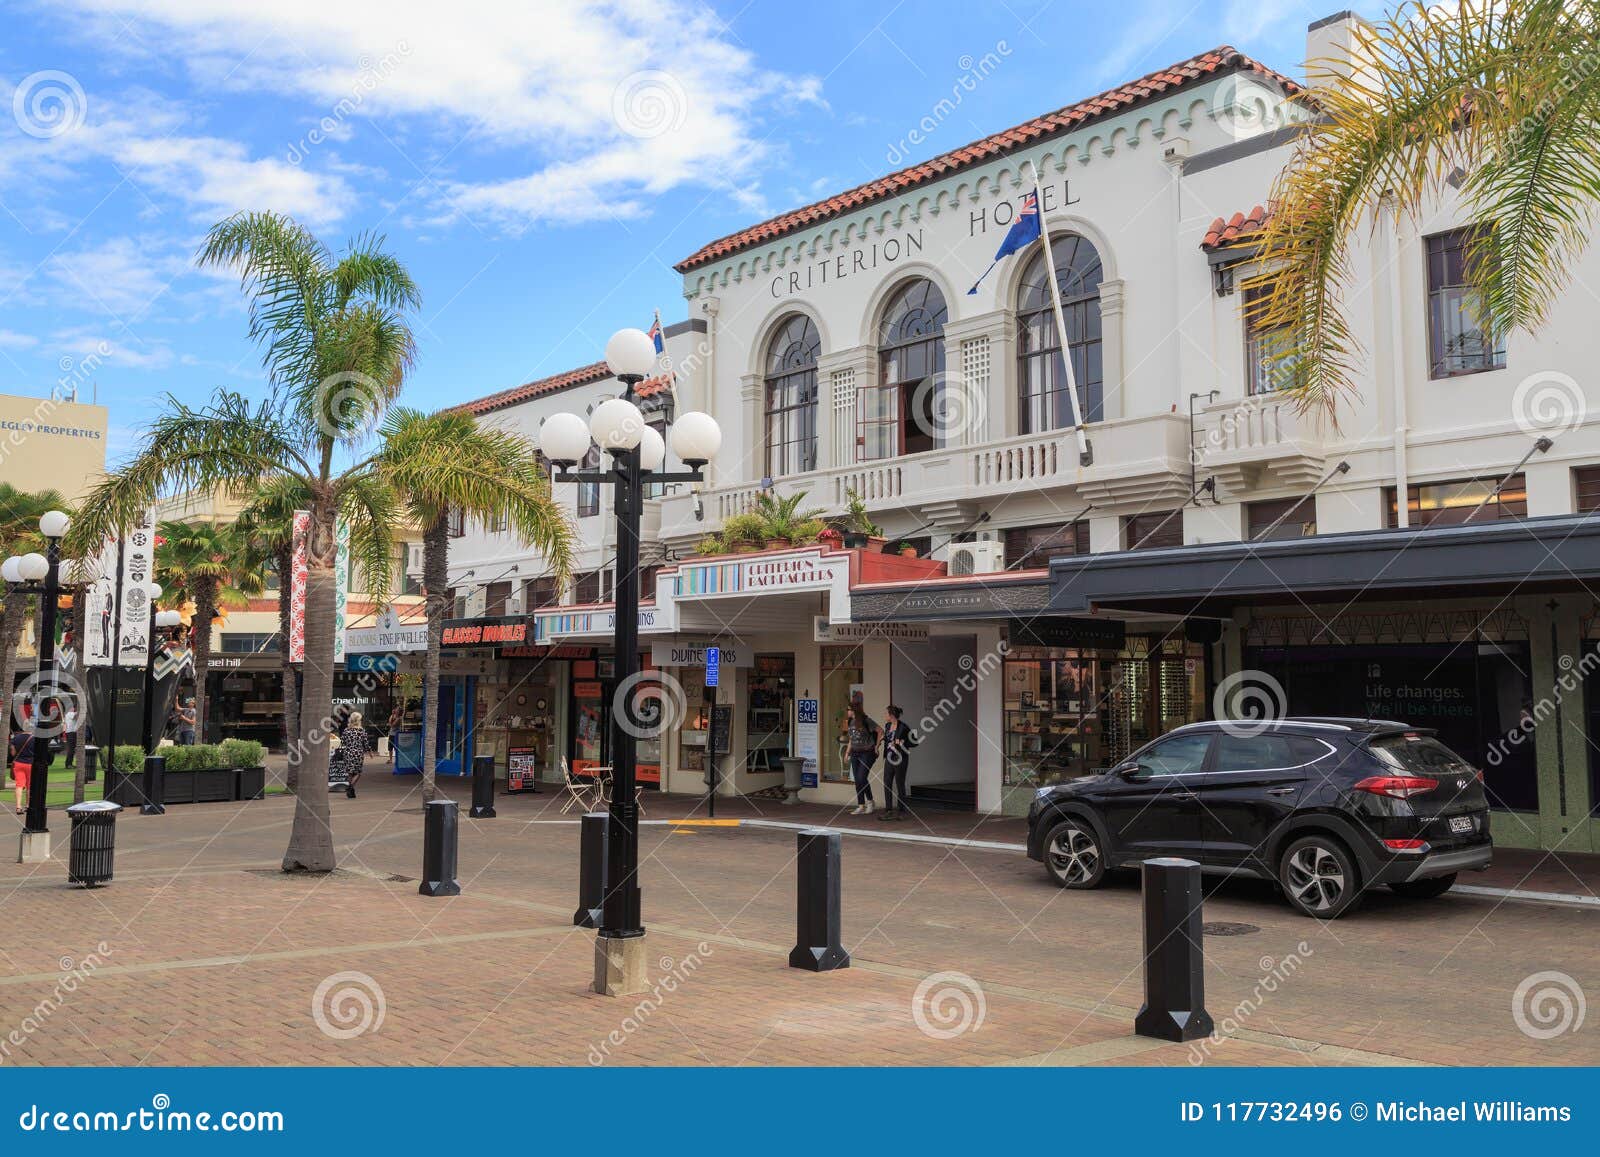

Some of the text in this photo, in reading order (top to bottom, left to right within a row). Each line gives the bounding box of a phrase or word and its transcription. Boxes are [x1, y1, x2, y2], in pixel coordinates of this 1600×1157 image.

[771, 229, 924, 298] CRITERION
[37, 425, 101, 439] PROPERTIES
[749, 560, 814, 576] CRITERION
[748, 569, 834, 587] BACKPACKERS
[379, 632, 394, 646] FINE
[394, 630, 428, 645] JEWELLER
[442, 624, 526, 645] CLASSIC MOBILES
[226, 658, 241, 667] hill
[671, 649, 703, 663] DIVINE
[1366, 684, 1392, 698] Life
[331, 697, 356, 705] chael
[799, 701, 817, 711] FOR
[1407, 702, 1427, 716] be
[799, 712, 817, 722] SALE
